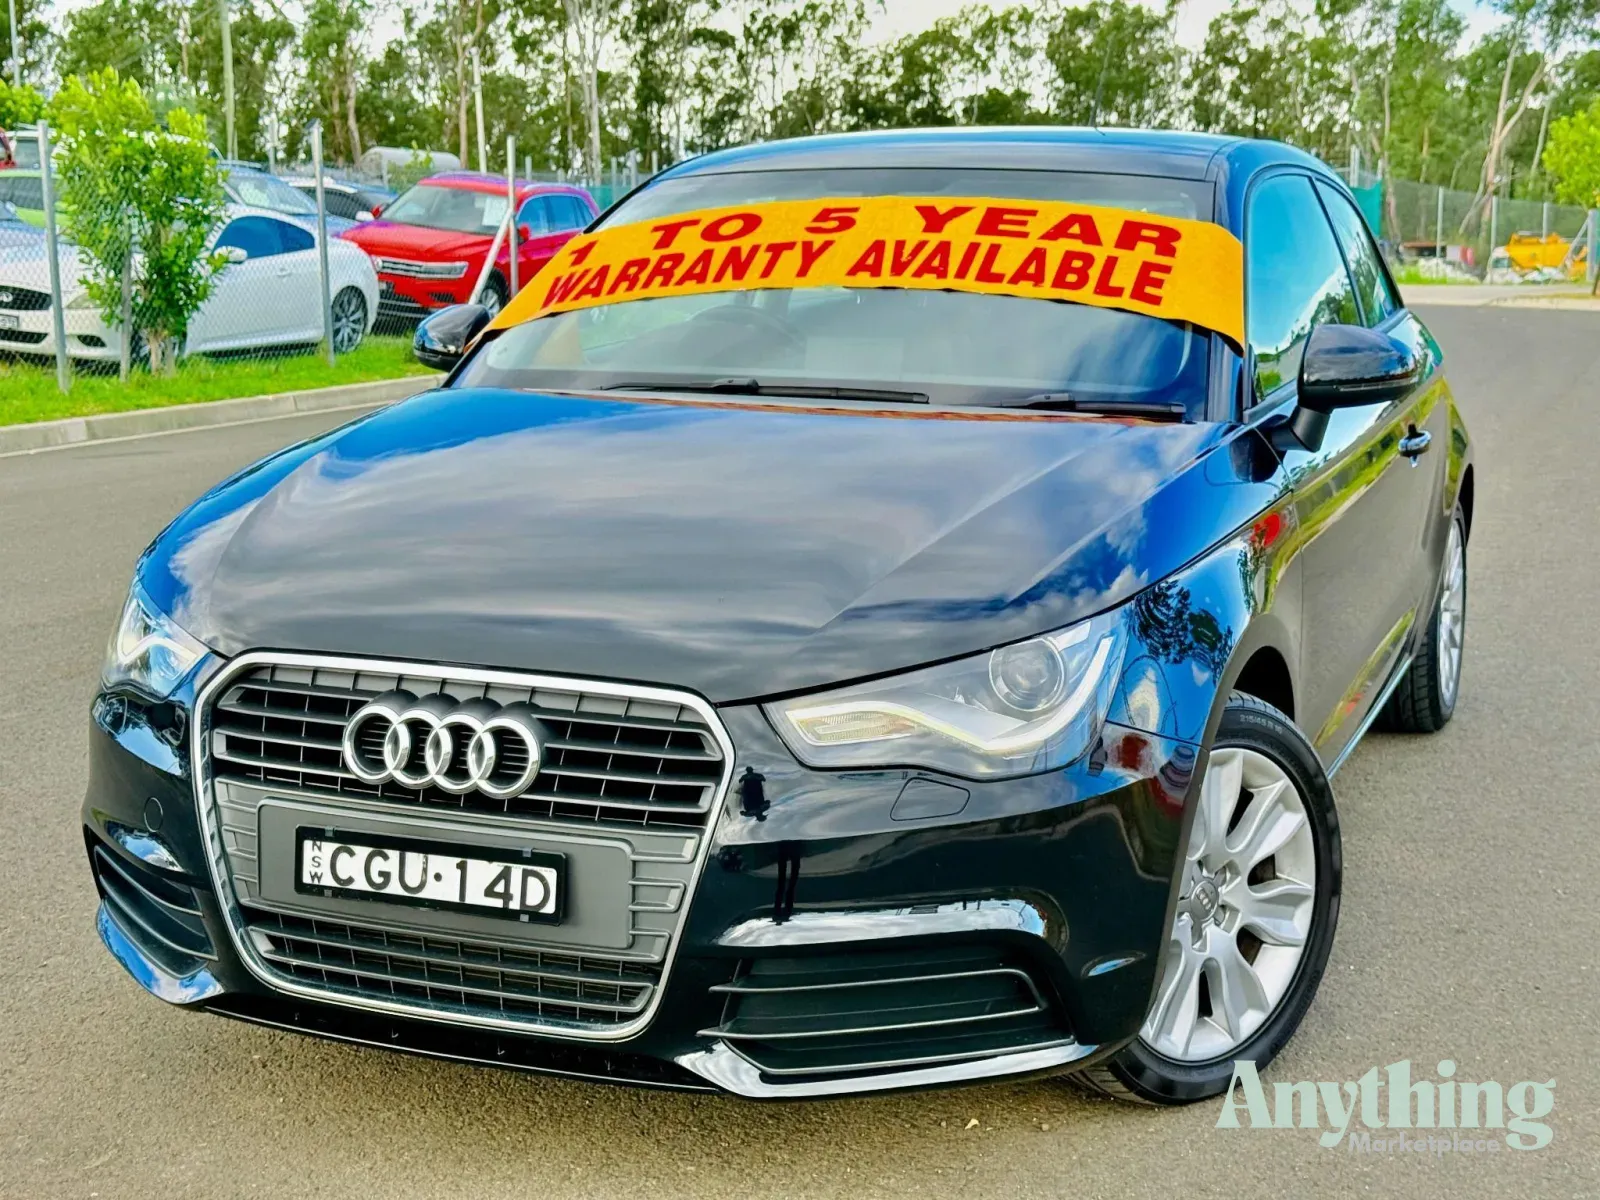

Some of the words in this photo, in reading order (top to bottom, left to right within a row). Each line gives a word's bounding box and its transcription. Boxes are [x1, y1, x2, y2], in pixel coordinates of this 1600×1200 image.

[568, 240, 599, 266] 1
[651, 213, 763, 250] TO
[804, 207, 860, 234] 5
[914, 205, 1182, 259] YEAR
[540, 240, 836, 310] WARRANTY
[845, 239, 1174, 306] AVAILABLE
